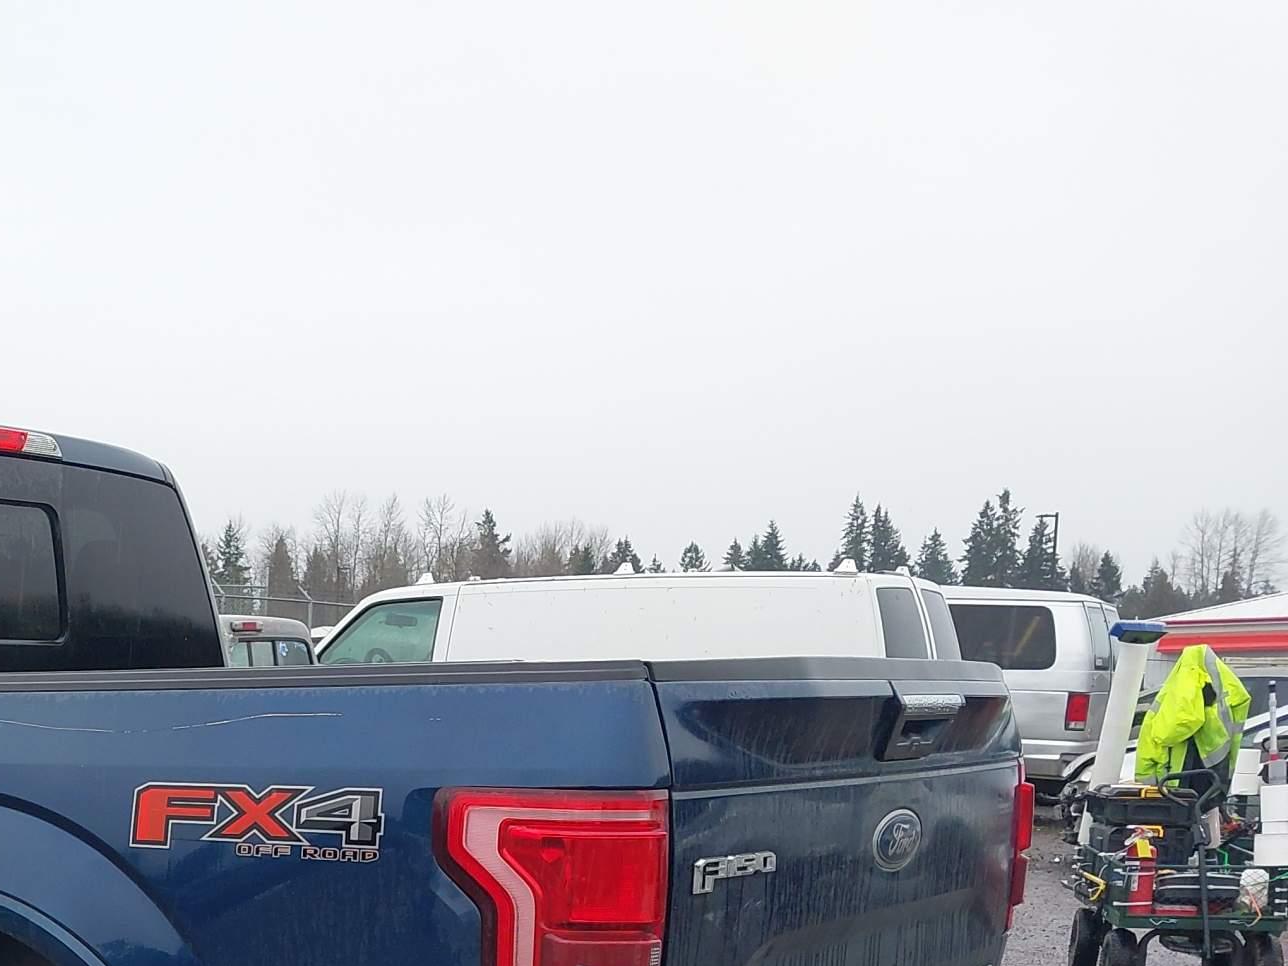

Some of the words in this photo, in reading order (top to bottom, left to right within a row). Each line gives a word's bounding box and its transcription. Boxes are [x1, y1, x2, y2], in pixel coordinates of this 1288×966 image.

[129, 782, 385, 849] FX4
[235, 843, 291, 858] OFF
[300, 846, 380, 862] ROAD
